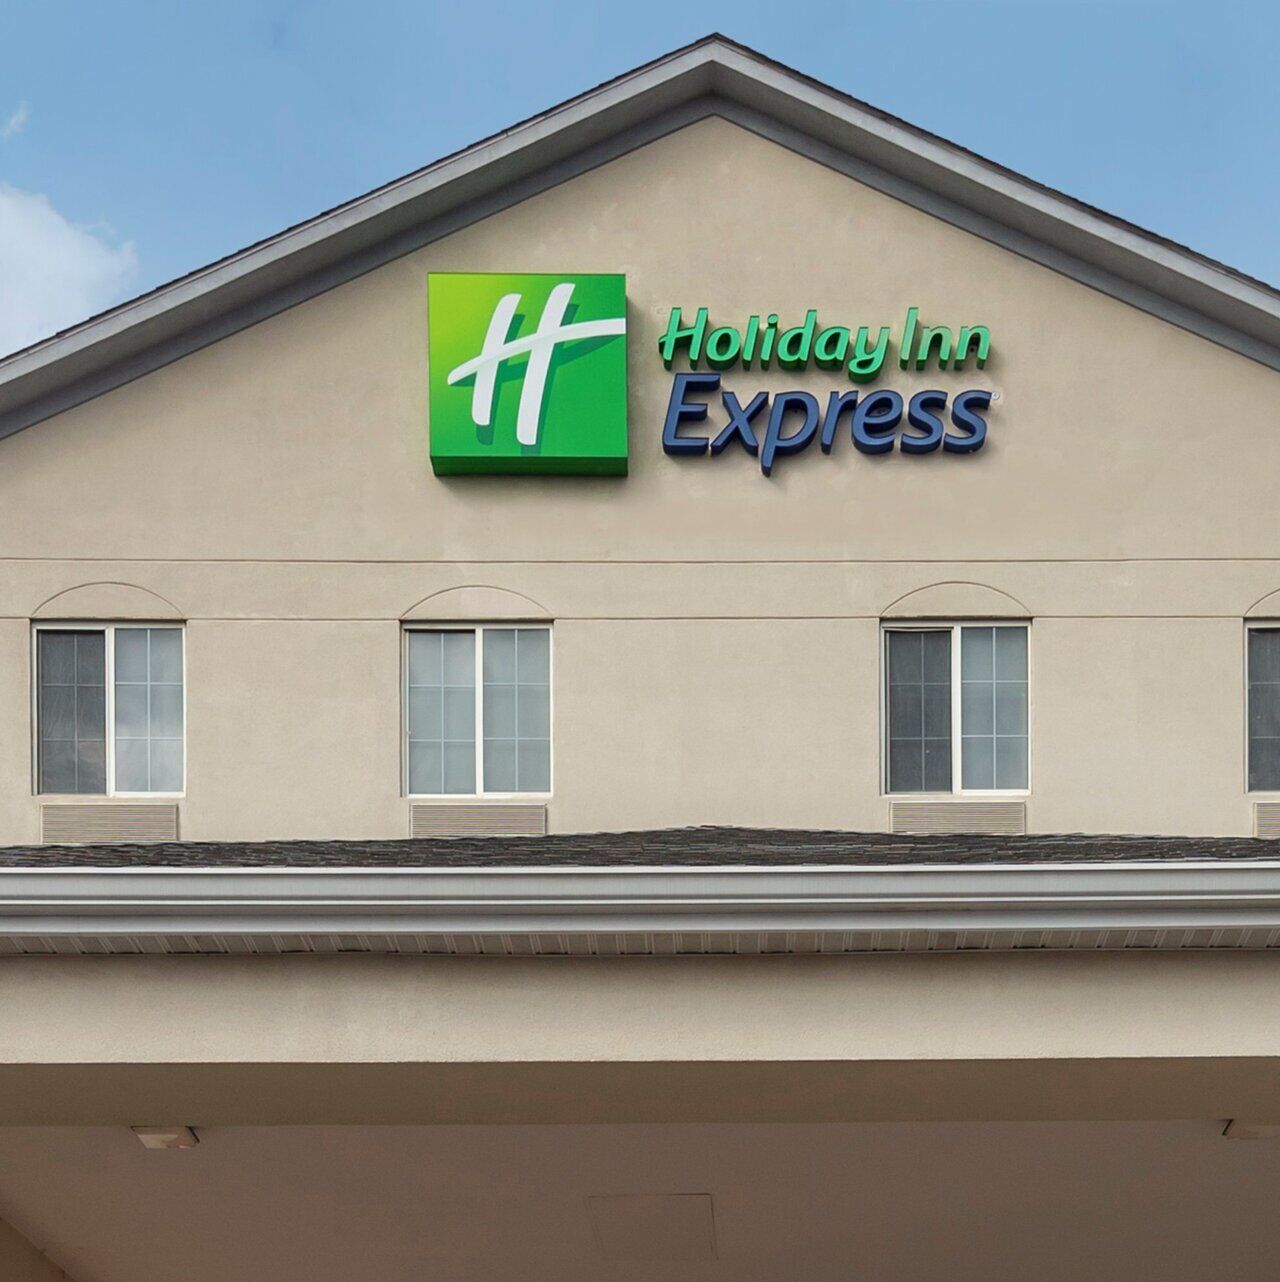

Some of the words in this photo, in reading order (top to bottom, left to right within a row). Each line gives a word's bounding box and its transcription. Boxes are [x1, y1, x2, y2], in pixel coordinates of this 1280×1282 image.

[658, 306, 890, 384] Holiday
[898, 306, 992, 371] Inn
[662, 372, 994, 478] Express
